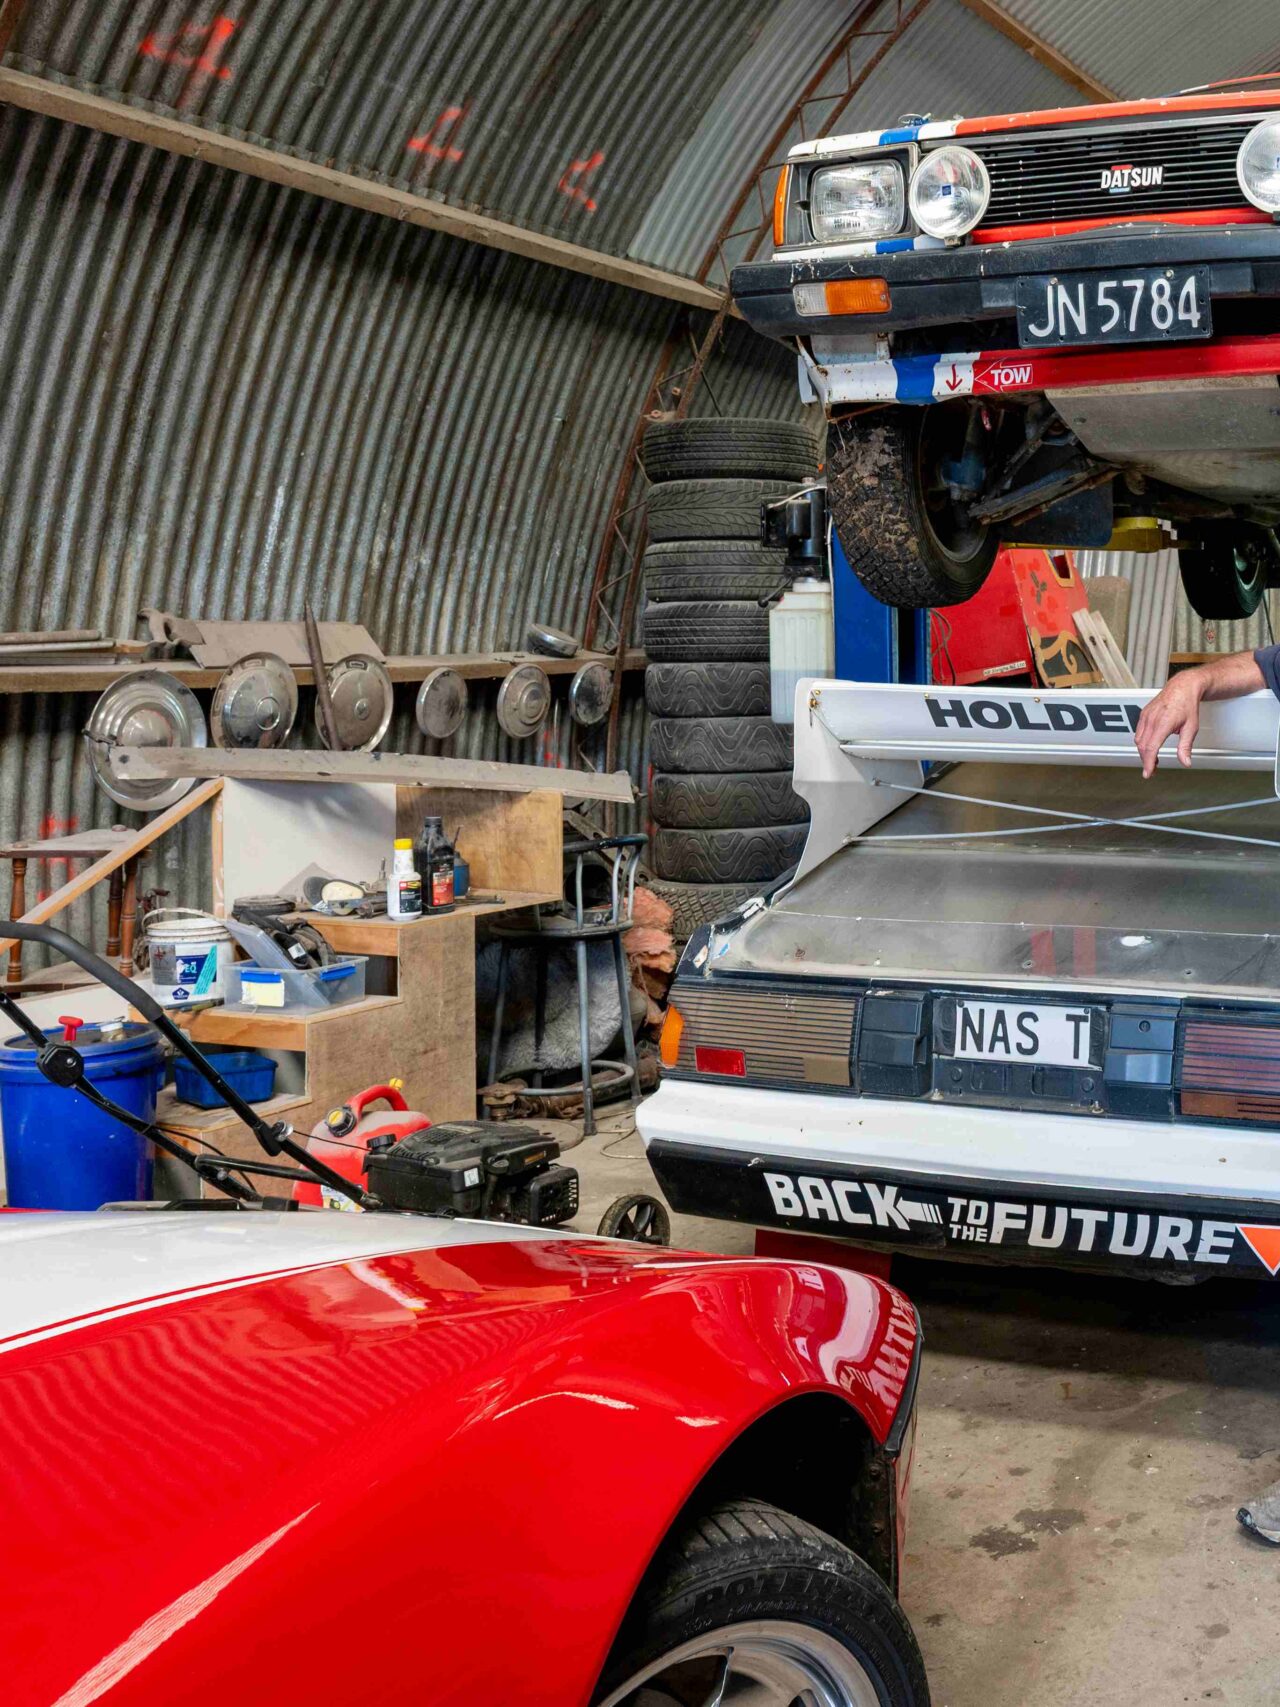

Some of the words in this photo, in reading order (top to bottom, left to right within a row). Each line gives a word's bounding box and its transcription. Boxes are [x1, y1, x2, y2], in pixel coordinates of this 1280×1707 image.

[1100, 165, 1163, 189] DATSUN
[990, 366, 1031, 386] TOW
[960, 1007, 1039, 1056] NAS
[1065, 1013, 1089, 1060] T
[763, 1172, 910, 1231] BACK
[947, 1197, 988, 1226] TO
[949, 1223, 988, 1242] THE
[989, 1201, 1237, 1264] FUTURE
